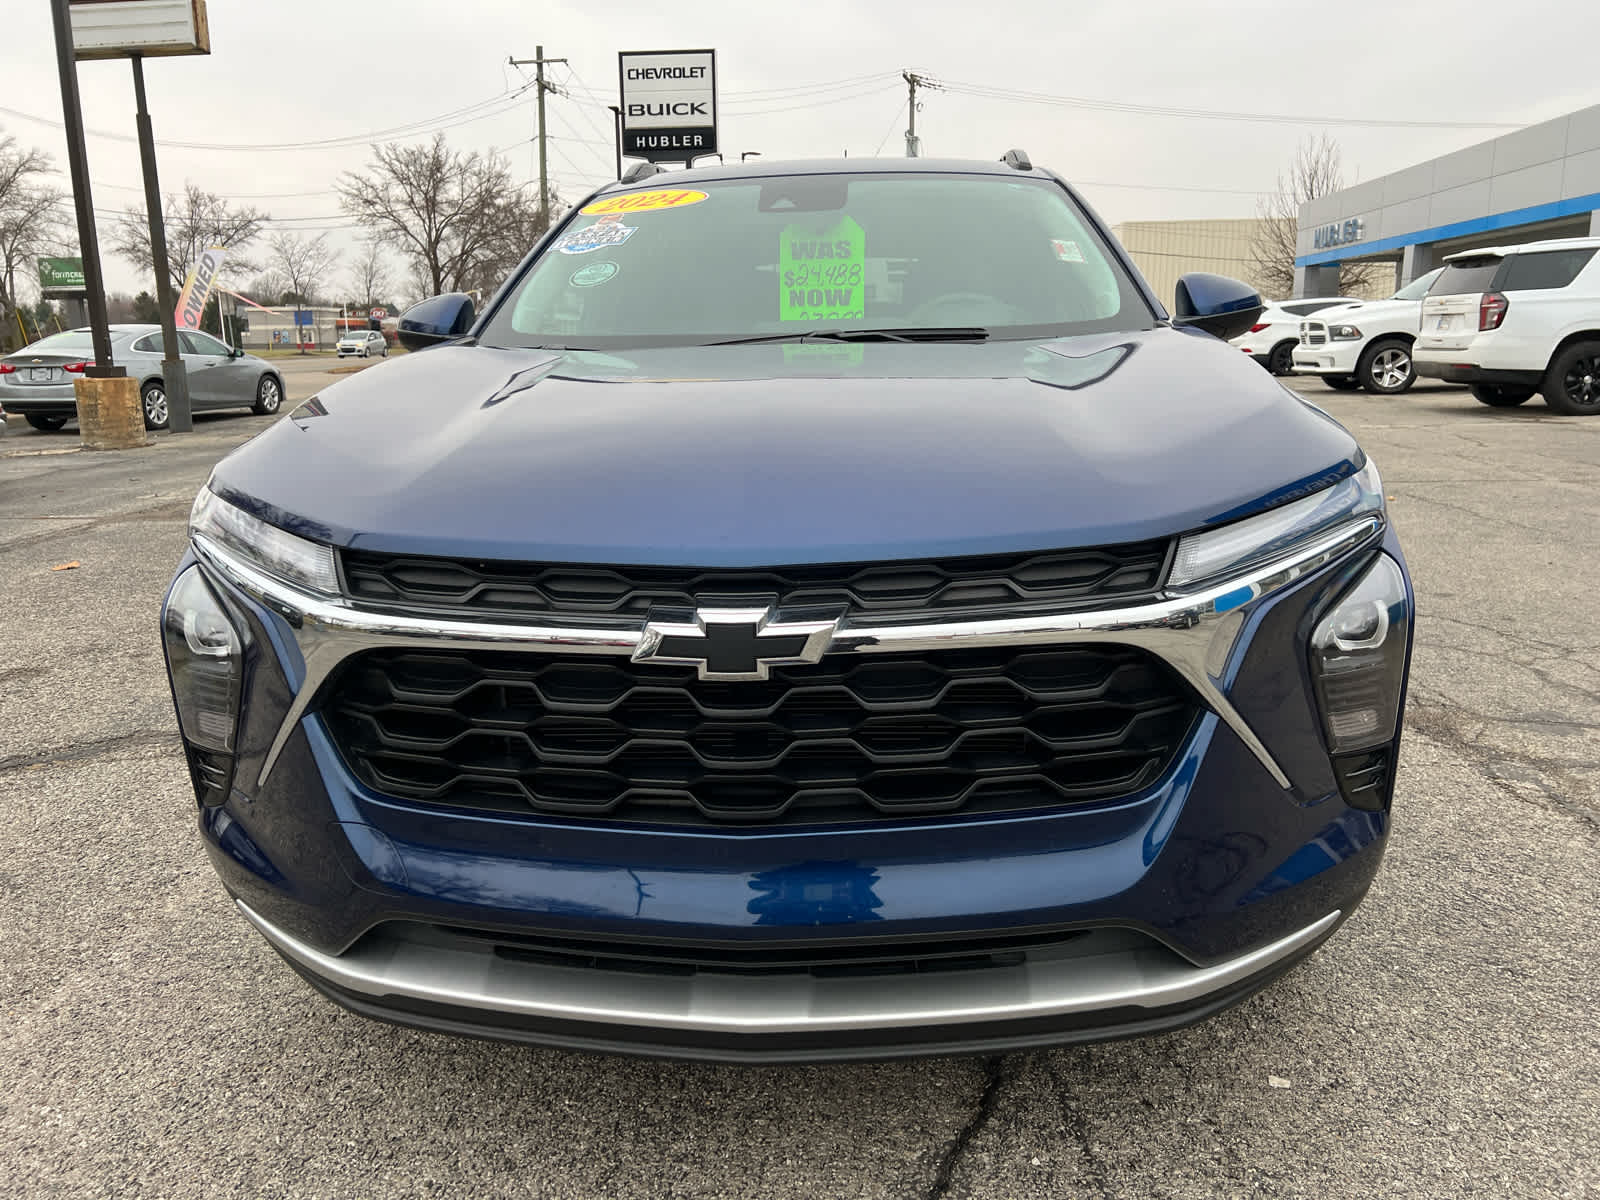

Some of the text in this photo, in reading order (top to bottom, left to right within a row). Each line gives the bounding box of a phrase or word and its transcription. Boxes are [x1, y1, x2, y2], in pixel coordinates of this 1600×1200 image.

[627, 66, 706, 80] CHEVROLET
[628, 102, 708, 116] BUICK
[636, 135, 703, 147] HUBLER
[595, 192, 689, 212] 2024
[791, 240, 851, 260] WAS
[183, 253, 216, 327] OWNED
[789, 289, 853, 307] NOW
